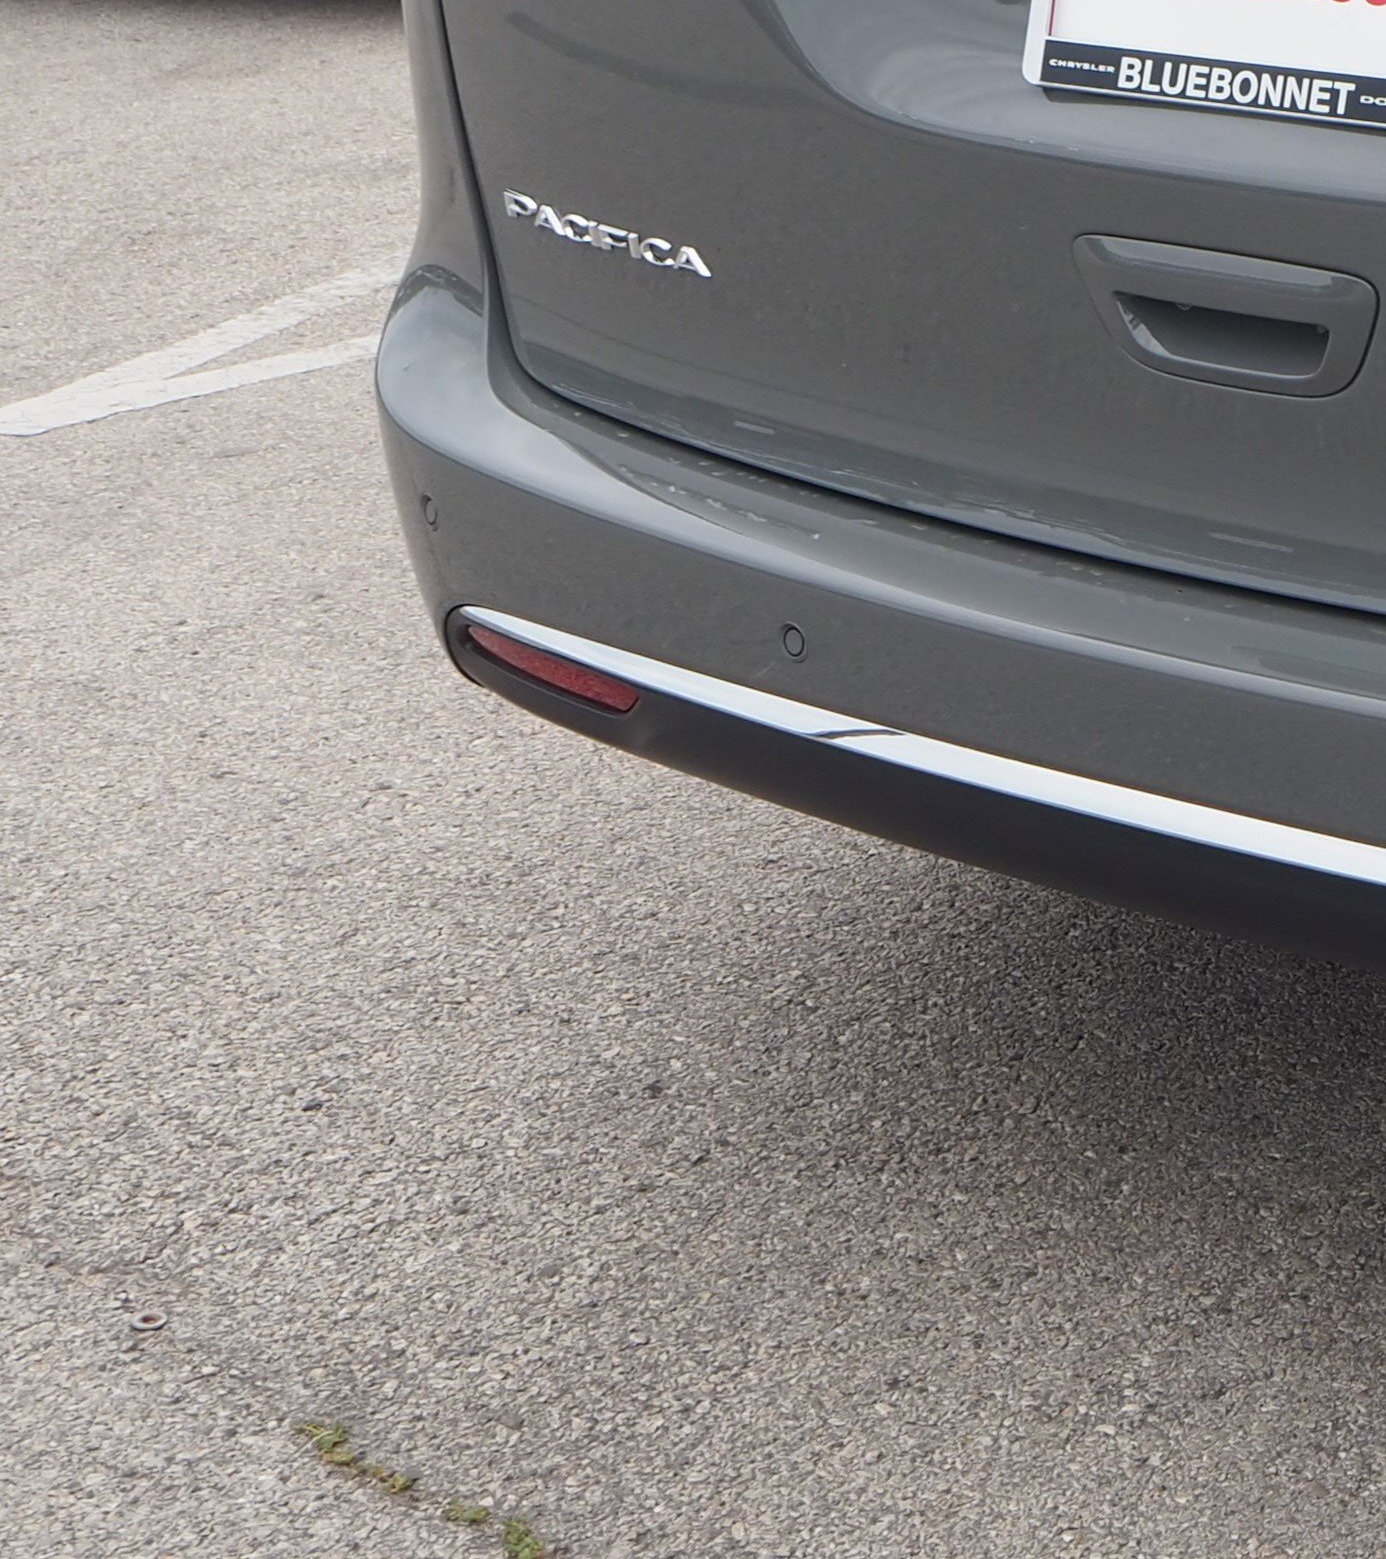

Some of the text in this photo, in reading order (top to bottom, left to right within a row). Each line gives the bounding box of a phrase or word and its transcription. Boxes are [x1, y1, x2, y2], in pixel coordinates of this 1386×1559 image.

[1048, 57, 1116, 74] CHRYSLER
[1117, 55, 1357, 115] BLUEBONNET
[503, 188, 712, 277] PACIFICA
